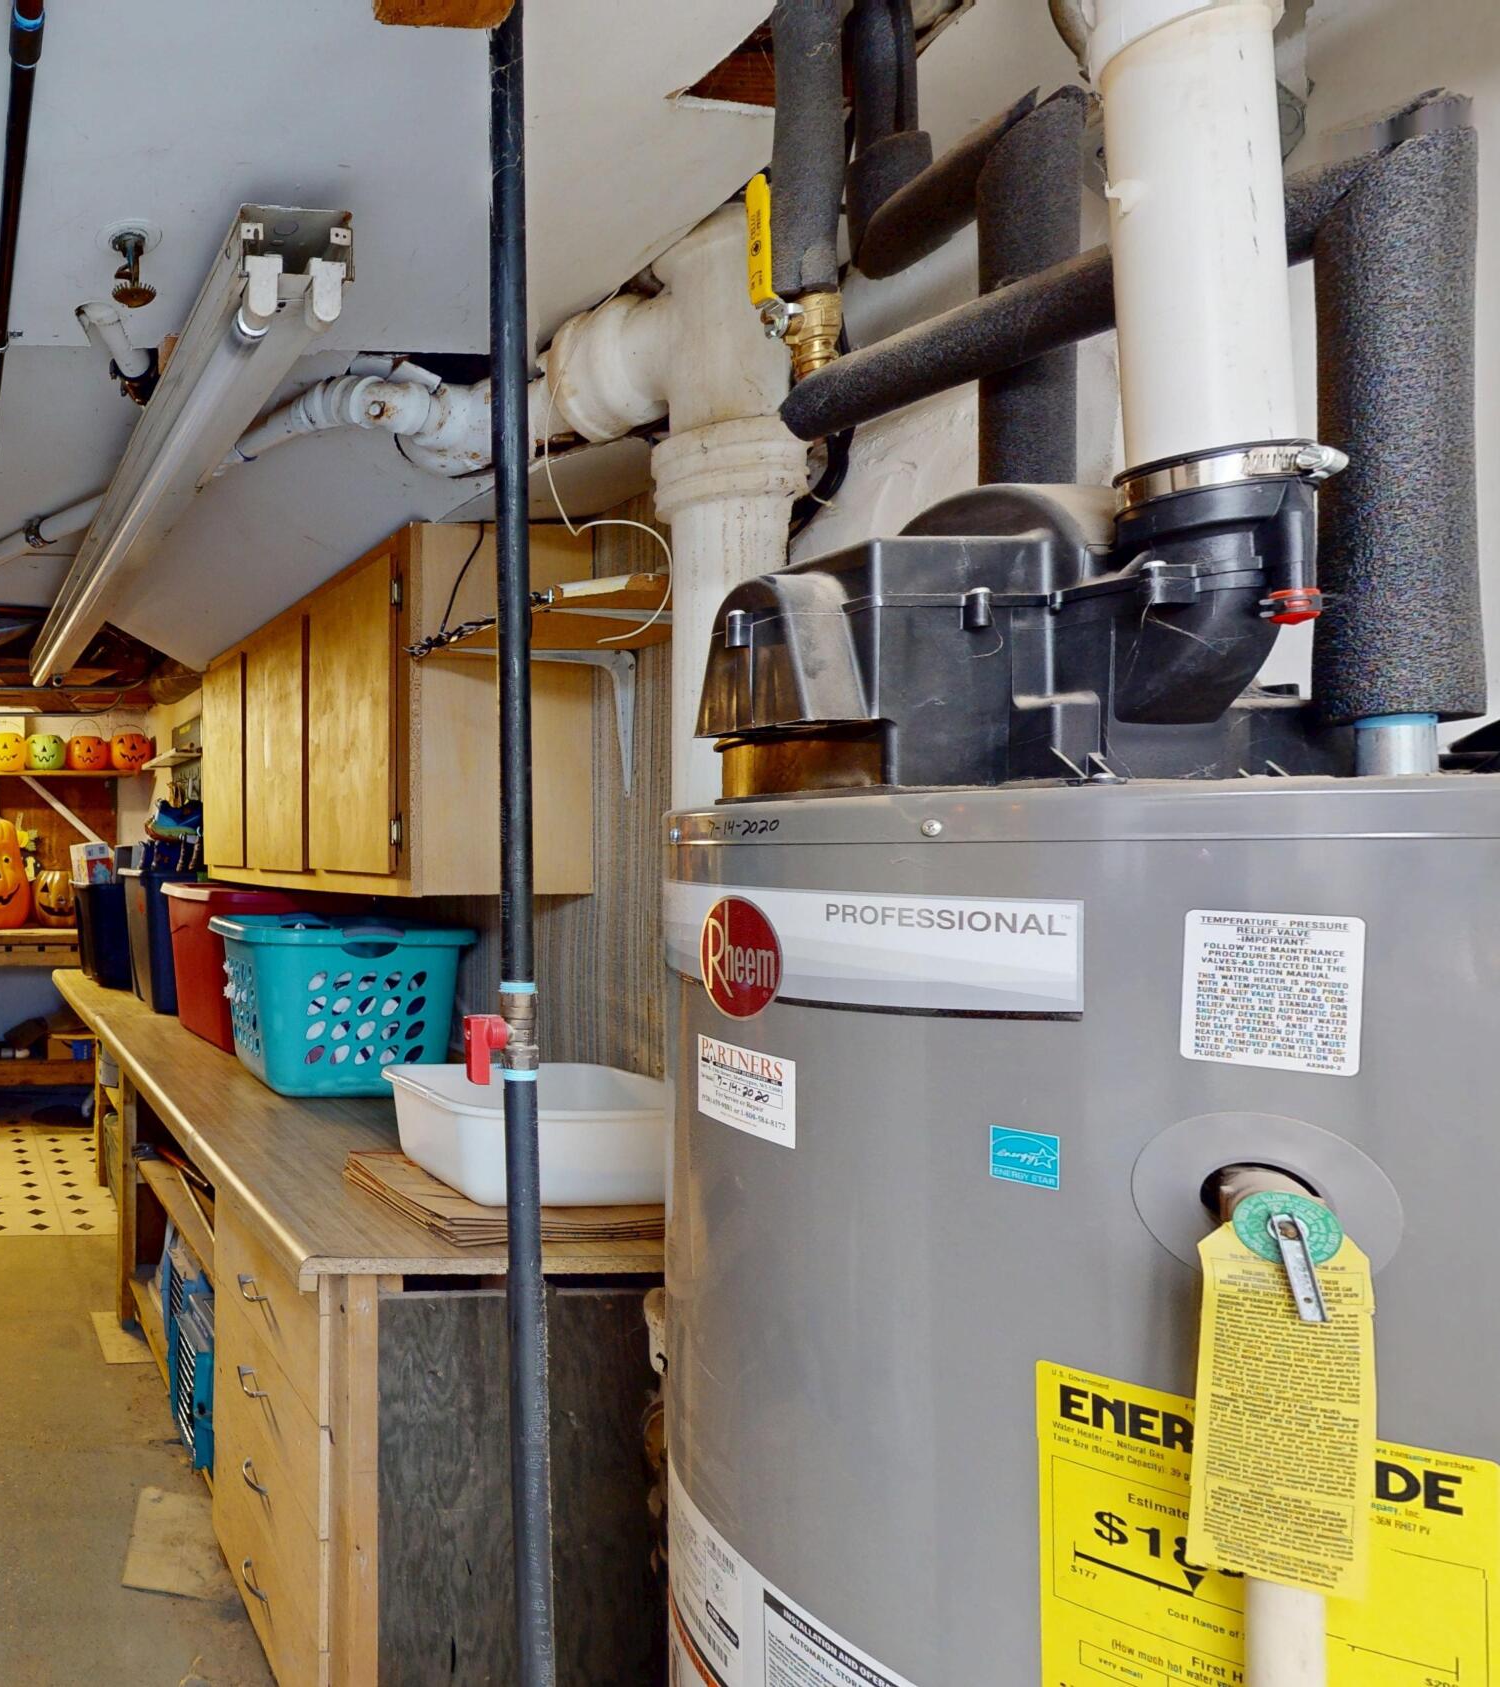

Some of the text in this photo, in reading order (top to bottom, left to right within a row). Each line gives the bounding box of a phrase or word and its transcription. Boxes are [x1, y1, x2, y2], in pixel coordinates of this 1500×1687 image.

[707, 819, 779, 837] 7-14-2020
[825, 903, 1067, 936] PROFESSIONAL
[1201, 916, 1279, 926] TEMPERATURE
[1289, 920, 1349, 930] PRESSURE
[1236, 926, 1310, 937] RELIEF VALVE
[707, 900, 776, 998] Rheem
[1203, 942, 1245, 951] FOLLOW
[1270, 946, 1345, 957] MAINTENANCE
[1208, 950, 1276, 960] PROCEDURES
[1303, 956, 1340, 964] RELIEF
[1201, 956, 1254, 966] VALVES-AS
[1258, 961, 1309, 970] DIRECTED
[1327, 965, 1347, 973] THE
[1215, 965, 1331, 979] INSTRUCTION MANUAL
[1221, 974, 1249, 982] WATER
[1253, 976, 1286, 984] HEATER
[1304, 980, 1349, 989] PROVIDED
[1234, 981, 1292, 992] TEMPERATURE
[1220, 988, 1248, 996] RELIEF
[1251, 990, 1275, 998] VALVE
[1279, 992, 1309, 1001] LISTED
[1196, 1000, 1223, 1008] RELIEF
[1226, 1002, 1255, 1011] VALVES
[1258, 1005, 1275, 1013] AND
[1278, 1007, 1327, 1017] AUTOMATIC
[1279, 1000, 1325, 1009] STANDARD
[1195, 1013, 1228, 1022] SUPPLY
[1238, 1010, 1273, 1019] DEVICES
[1317, 1018, 1347, 1026] WATER
[1214, 1022, 1232, 1030] SAFE
[1235, 1025, 1282, 1034] OPERATION
[1298, 1030, 1313, 1038] THE
[1316, 1032, 1347, 1040] WATER
[1227, 1038, 1268, 1048] REMOVED
[1270, 1042, 1295, 1050] FROM
[1249, 1033, 1276, 1041] RELIEF
[1321, 1040, 1346, 1048] MUST
[701, 1037, 783, 1081] PARTNERS
[1225, 1045, 1249, 1053] POINT
[1268, 1049, 1328, 1061] INSTALLATION
[1332, 1055, 1345, 1063] OR
[993, 1167, 1056, 1185] ENERGY STAR
[1068, 1373, 1110, 1390] Government
[1052, 1421, 1075, 1434] Water
[1077, 1429, 1103, 1442] Heater
[1116, 1440, 1147, 1456] Natural
[1149, 1448, 1165, 1461] Gas
[1052, 1432, 1071, 1445] Tank
[1073, 1439, 1089, 1450] Size
[1091, 1445, 1125, 1461] (Storage
[1127, 1492, 1190, 1521] Estimate
[1070, 1564, 1098, 1581] $177
[1167, 1608, 1240, 1639] Cost Range of
[783, 1609, 838, 1657] INSTALLATION
[837, 1650, 859, 1671] AND
[789, 1632, 835, 1673] AUTOMATIC
[1098, 1656, 1144, 1680] very small
[1111, 1638, 1135, 1657] (How
[1137, 1649, 1165, 1669] much
[1167, 1656, 1183, 1675] hot
[1185, 1667, 1213, 1687] water
[1191, 1655, 1226, 1678] First
